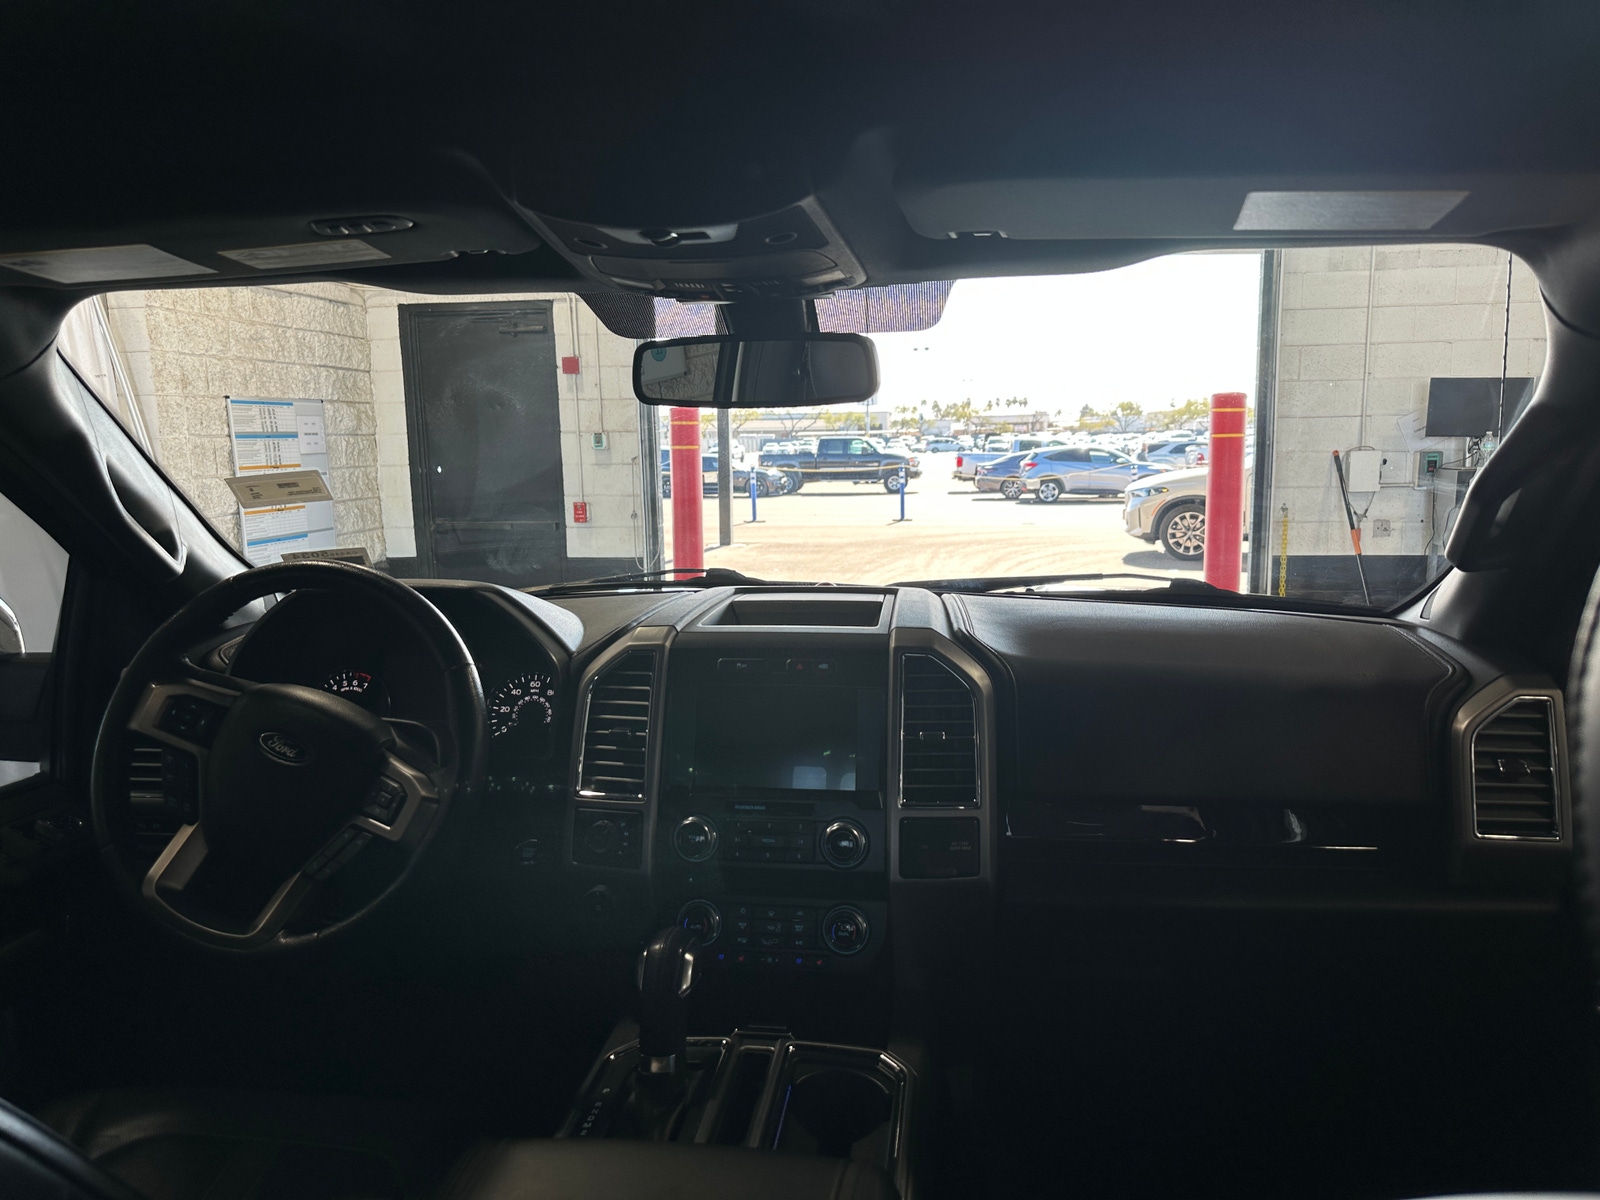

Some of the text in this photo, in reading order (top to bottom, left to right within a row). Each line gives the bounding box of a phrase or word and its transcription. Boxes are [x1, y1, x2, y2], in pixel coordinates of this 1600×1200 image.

[529, 680, 541, 688] 60
[510, 688, 522, 696] 40
[499, 705, 511, 713] 20
[267, 735, 299, 758] Ford
